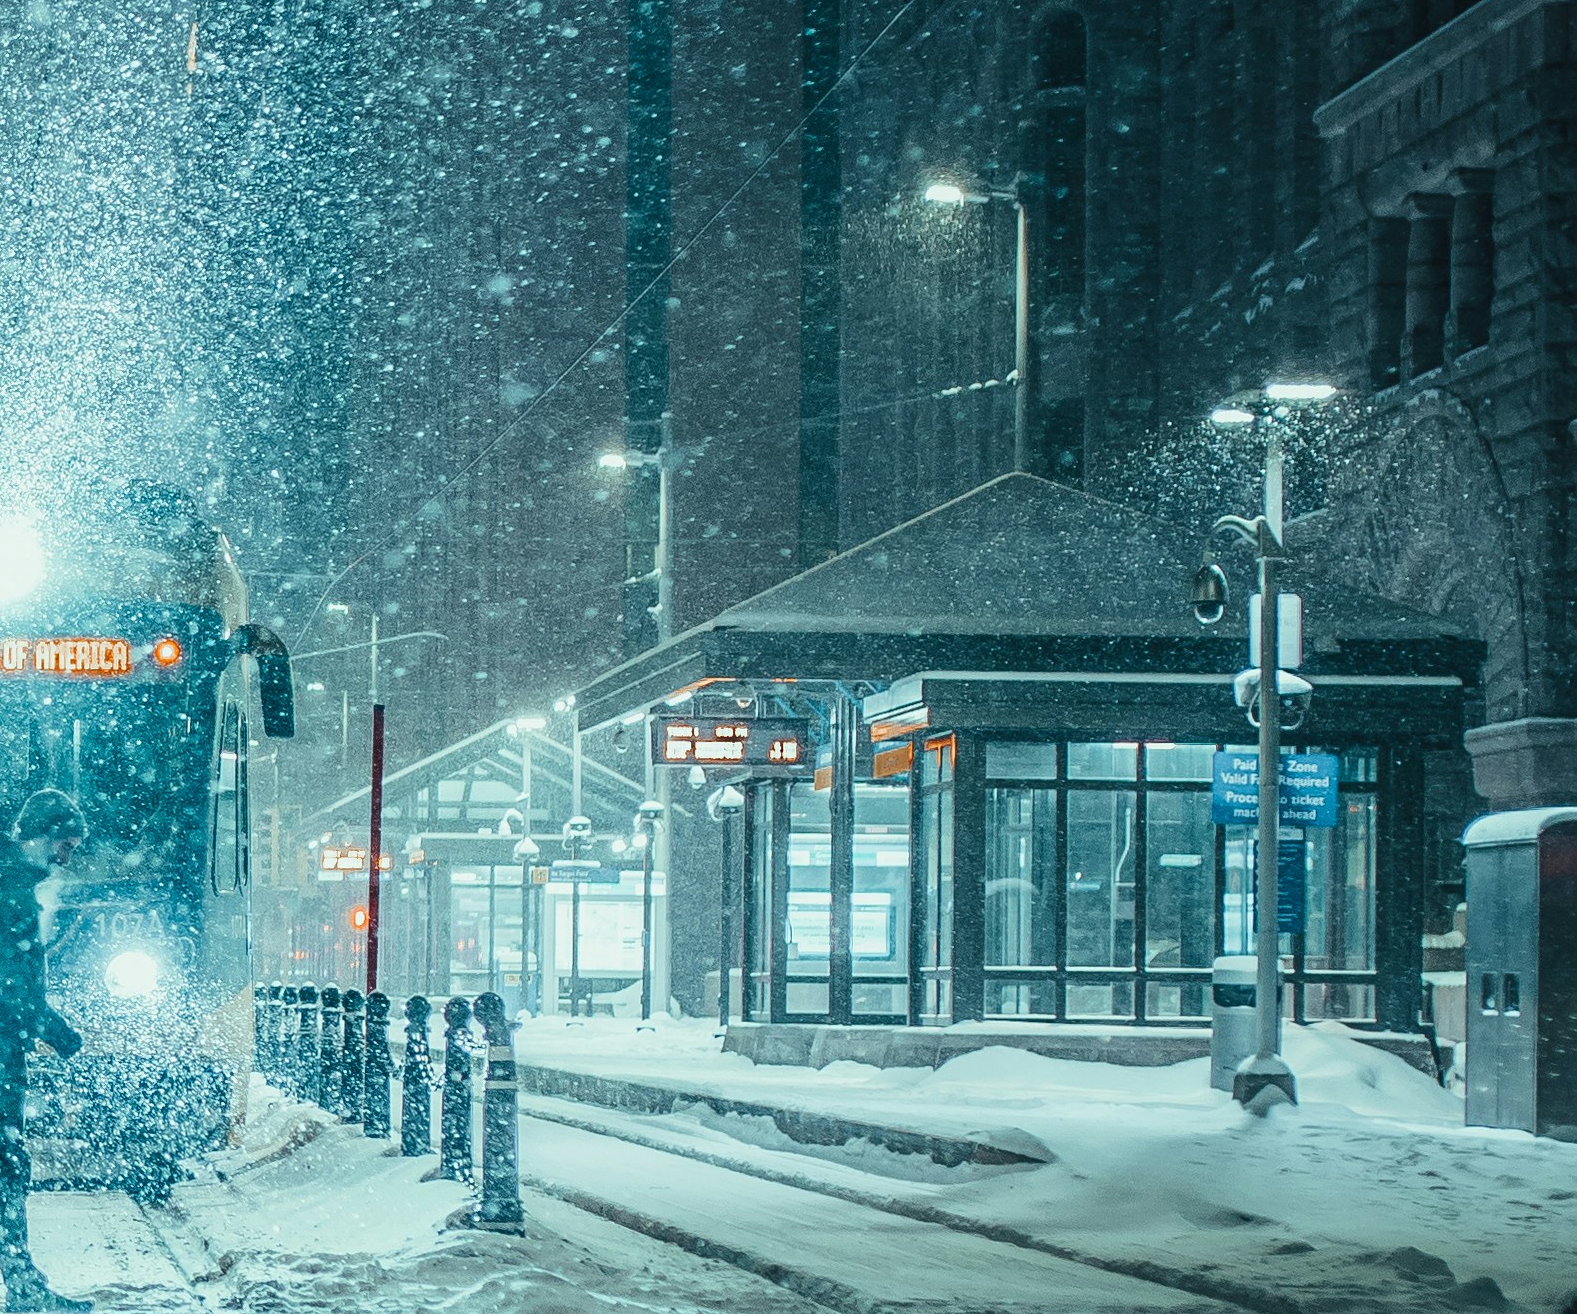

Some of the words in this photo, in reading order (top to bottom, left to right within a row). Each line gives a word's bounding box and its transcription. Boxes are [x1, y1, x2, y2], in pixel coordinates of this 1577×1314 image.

[3, 639, 30, 670] OF
[35, 639, 128, 671] AMERICA
[1233, 758, 1257, 771] Paid
[1287, 760, 1319, 773] Zone
[1220, 772, 1248, 785] Valid
[1279, 775, 1330, 789] Required
[1291, 795, 1326, 806] ticket
[1282, 809, 1317, 820] ahead
[95, 909, 164, 938] 107A
